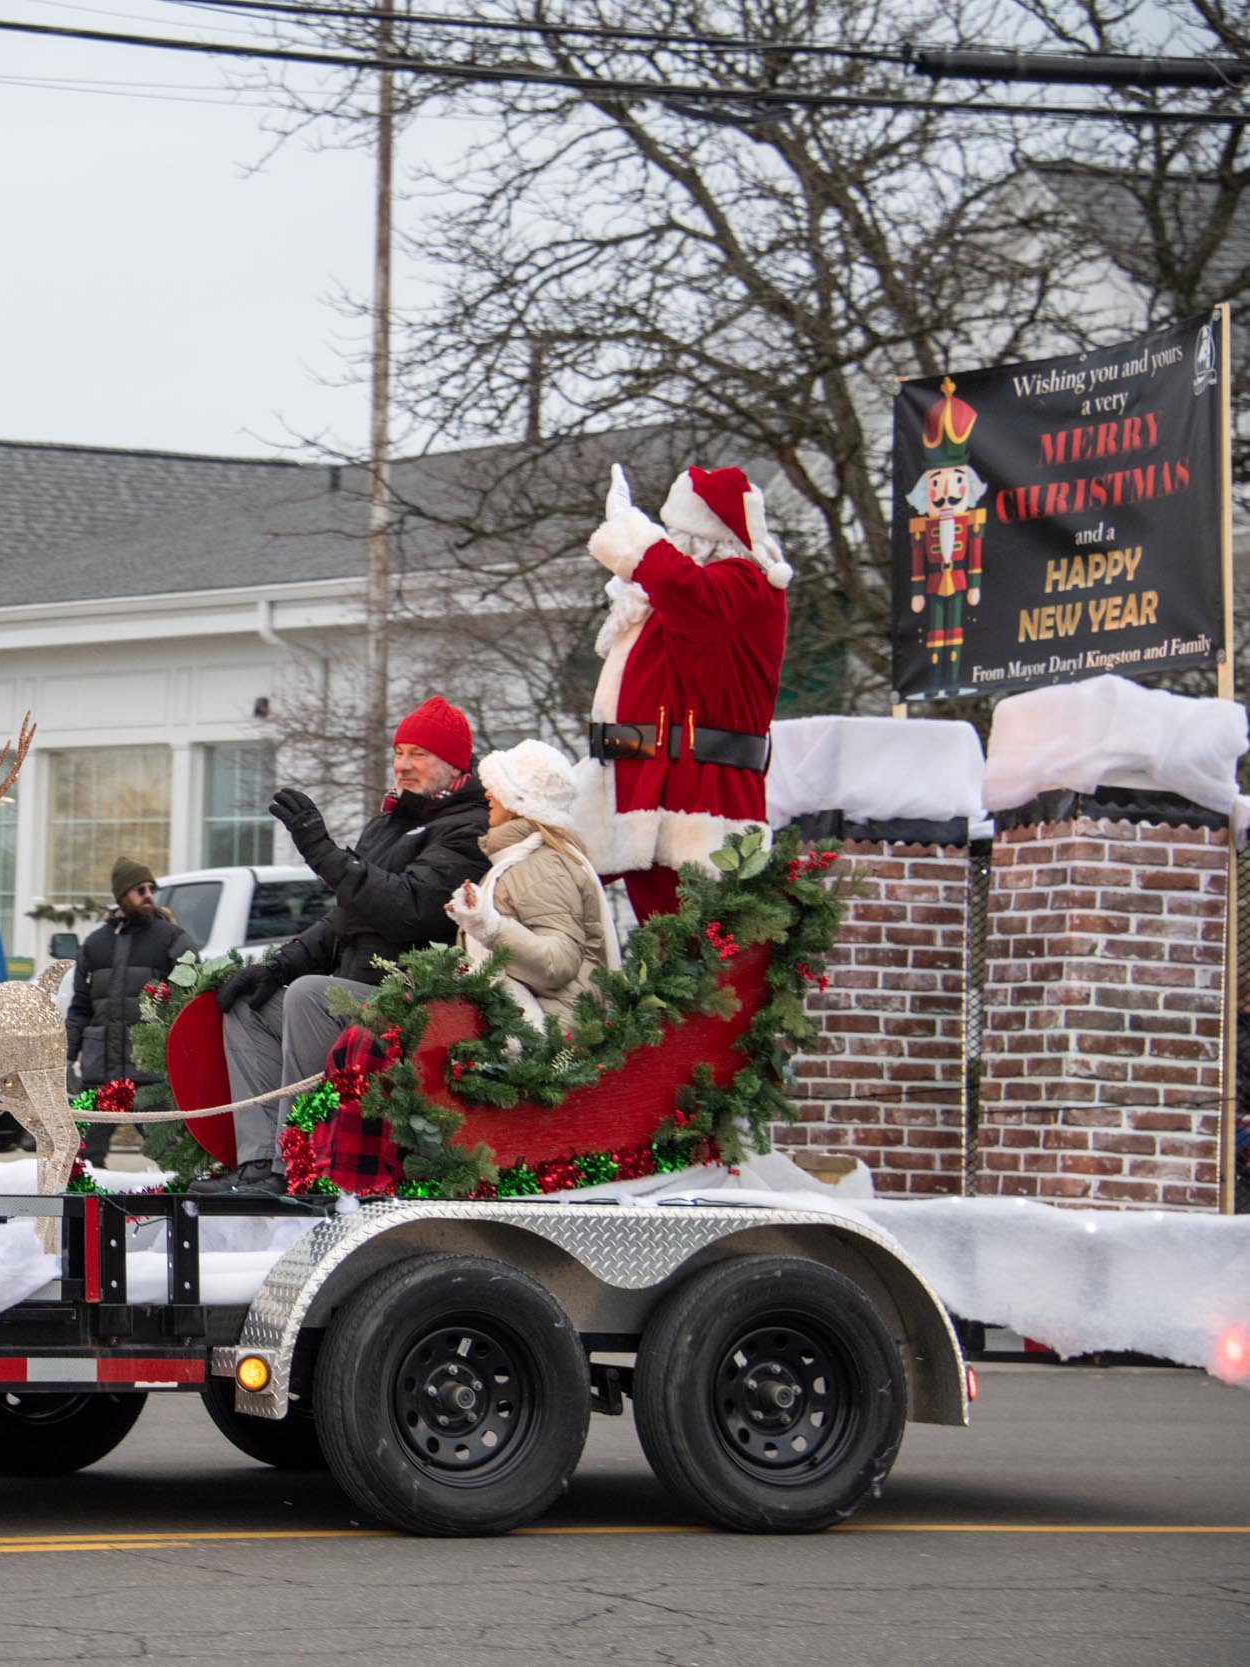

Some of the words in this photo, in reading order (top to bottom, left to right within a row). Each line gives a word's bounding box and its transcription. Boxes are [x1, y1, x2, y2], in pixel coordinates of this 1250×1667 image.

[1012, 368, 1087, 398] Wishing
[1089, 363, 1119, 392] you
[1121, 349, 1149, 379] and
[1151, 345, 1183, 378] yours
[1081, 400, 1091, 416] a
[1095, 391, 1129, 416] very
[1039, 411, 1162, 467] MERRY
[996, 457, 1190, 524] CHRISTMAS
[1074, 521, 1105, 546] and
[1106, 526, 1116, 541] a
[1044, 546, 1143, 593] HAPPY
[1018, 602, 1082, 643] NEW
[1088, 590, 1159, 632] YEAR
[971, 665, 1005, 683] From
[1007, 660, 1047, 682] Mayor
[1048, 652, 1084, 676] Daryl
[1085, 650, 1141, 671] Kingston
[1143, 639, 1168, 660] and
[1170, 634, 1211, 657] Family
